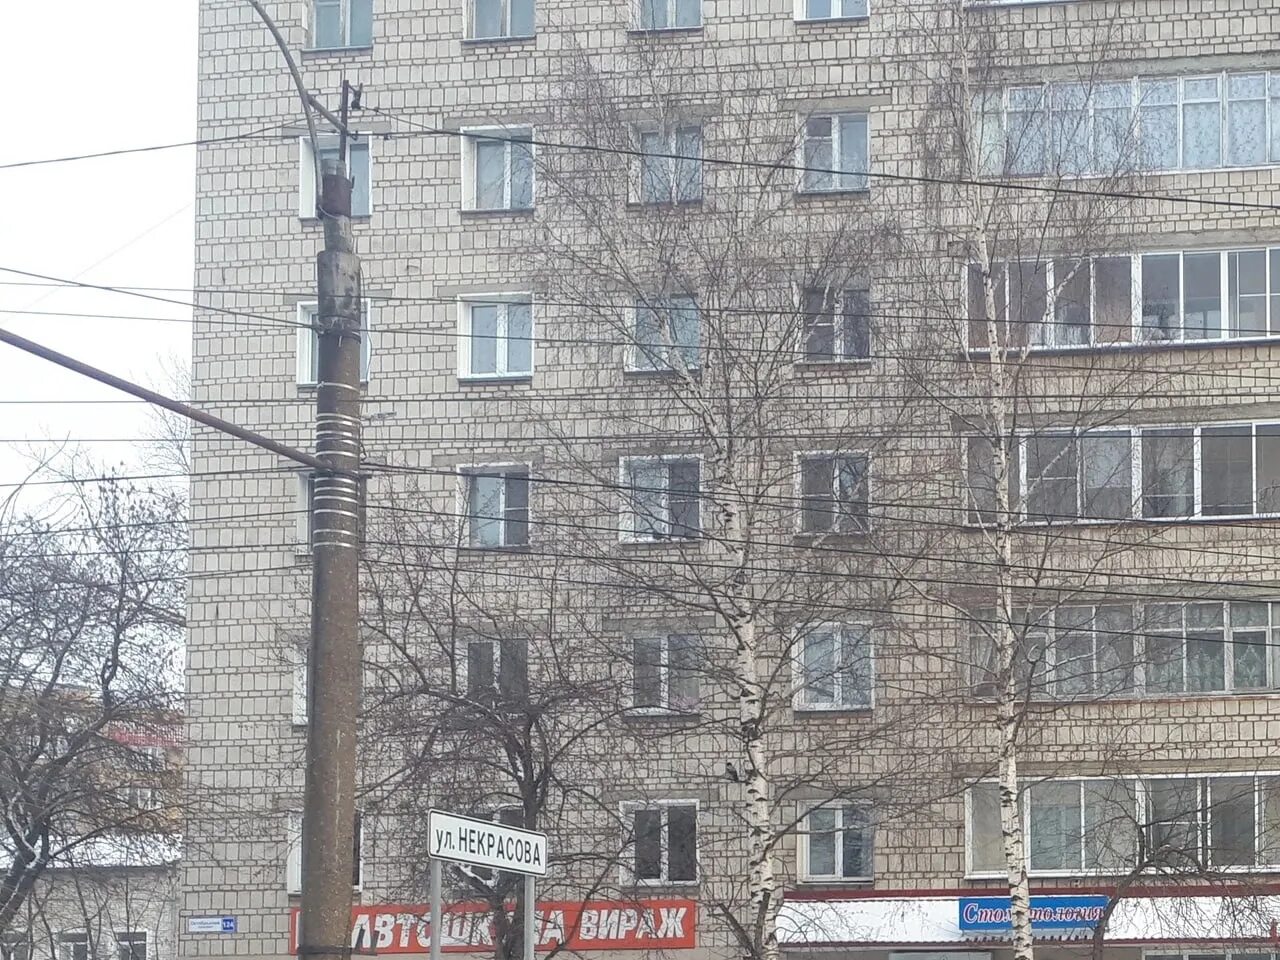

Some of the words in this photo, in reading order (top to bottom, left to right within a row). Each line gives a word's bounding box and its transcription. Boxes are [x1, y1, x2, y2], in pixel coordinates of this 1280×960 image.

[436, 829, 455, 854] ул.
[458, 827, 541, 866] НЕКРАСОВА
[579, 907, 687, 940] ВИРАЖ
